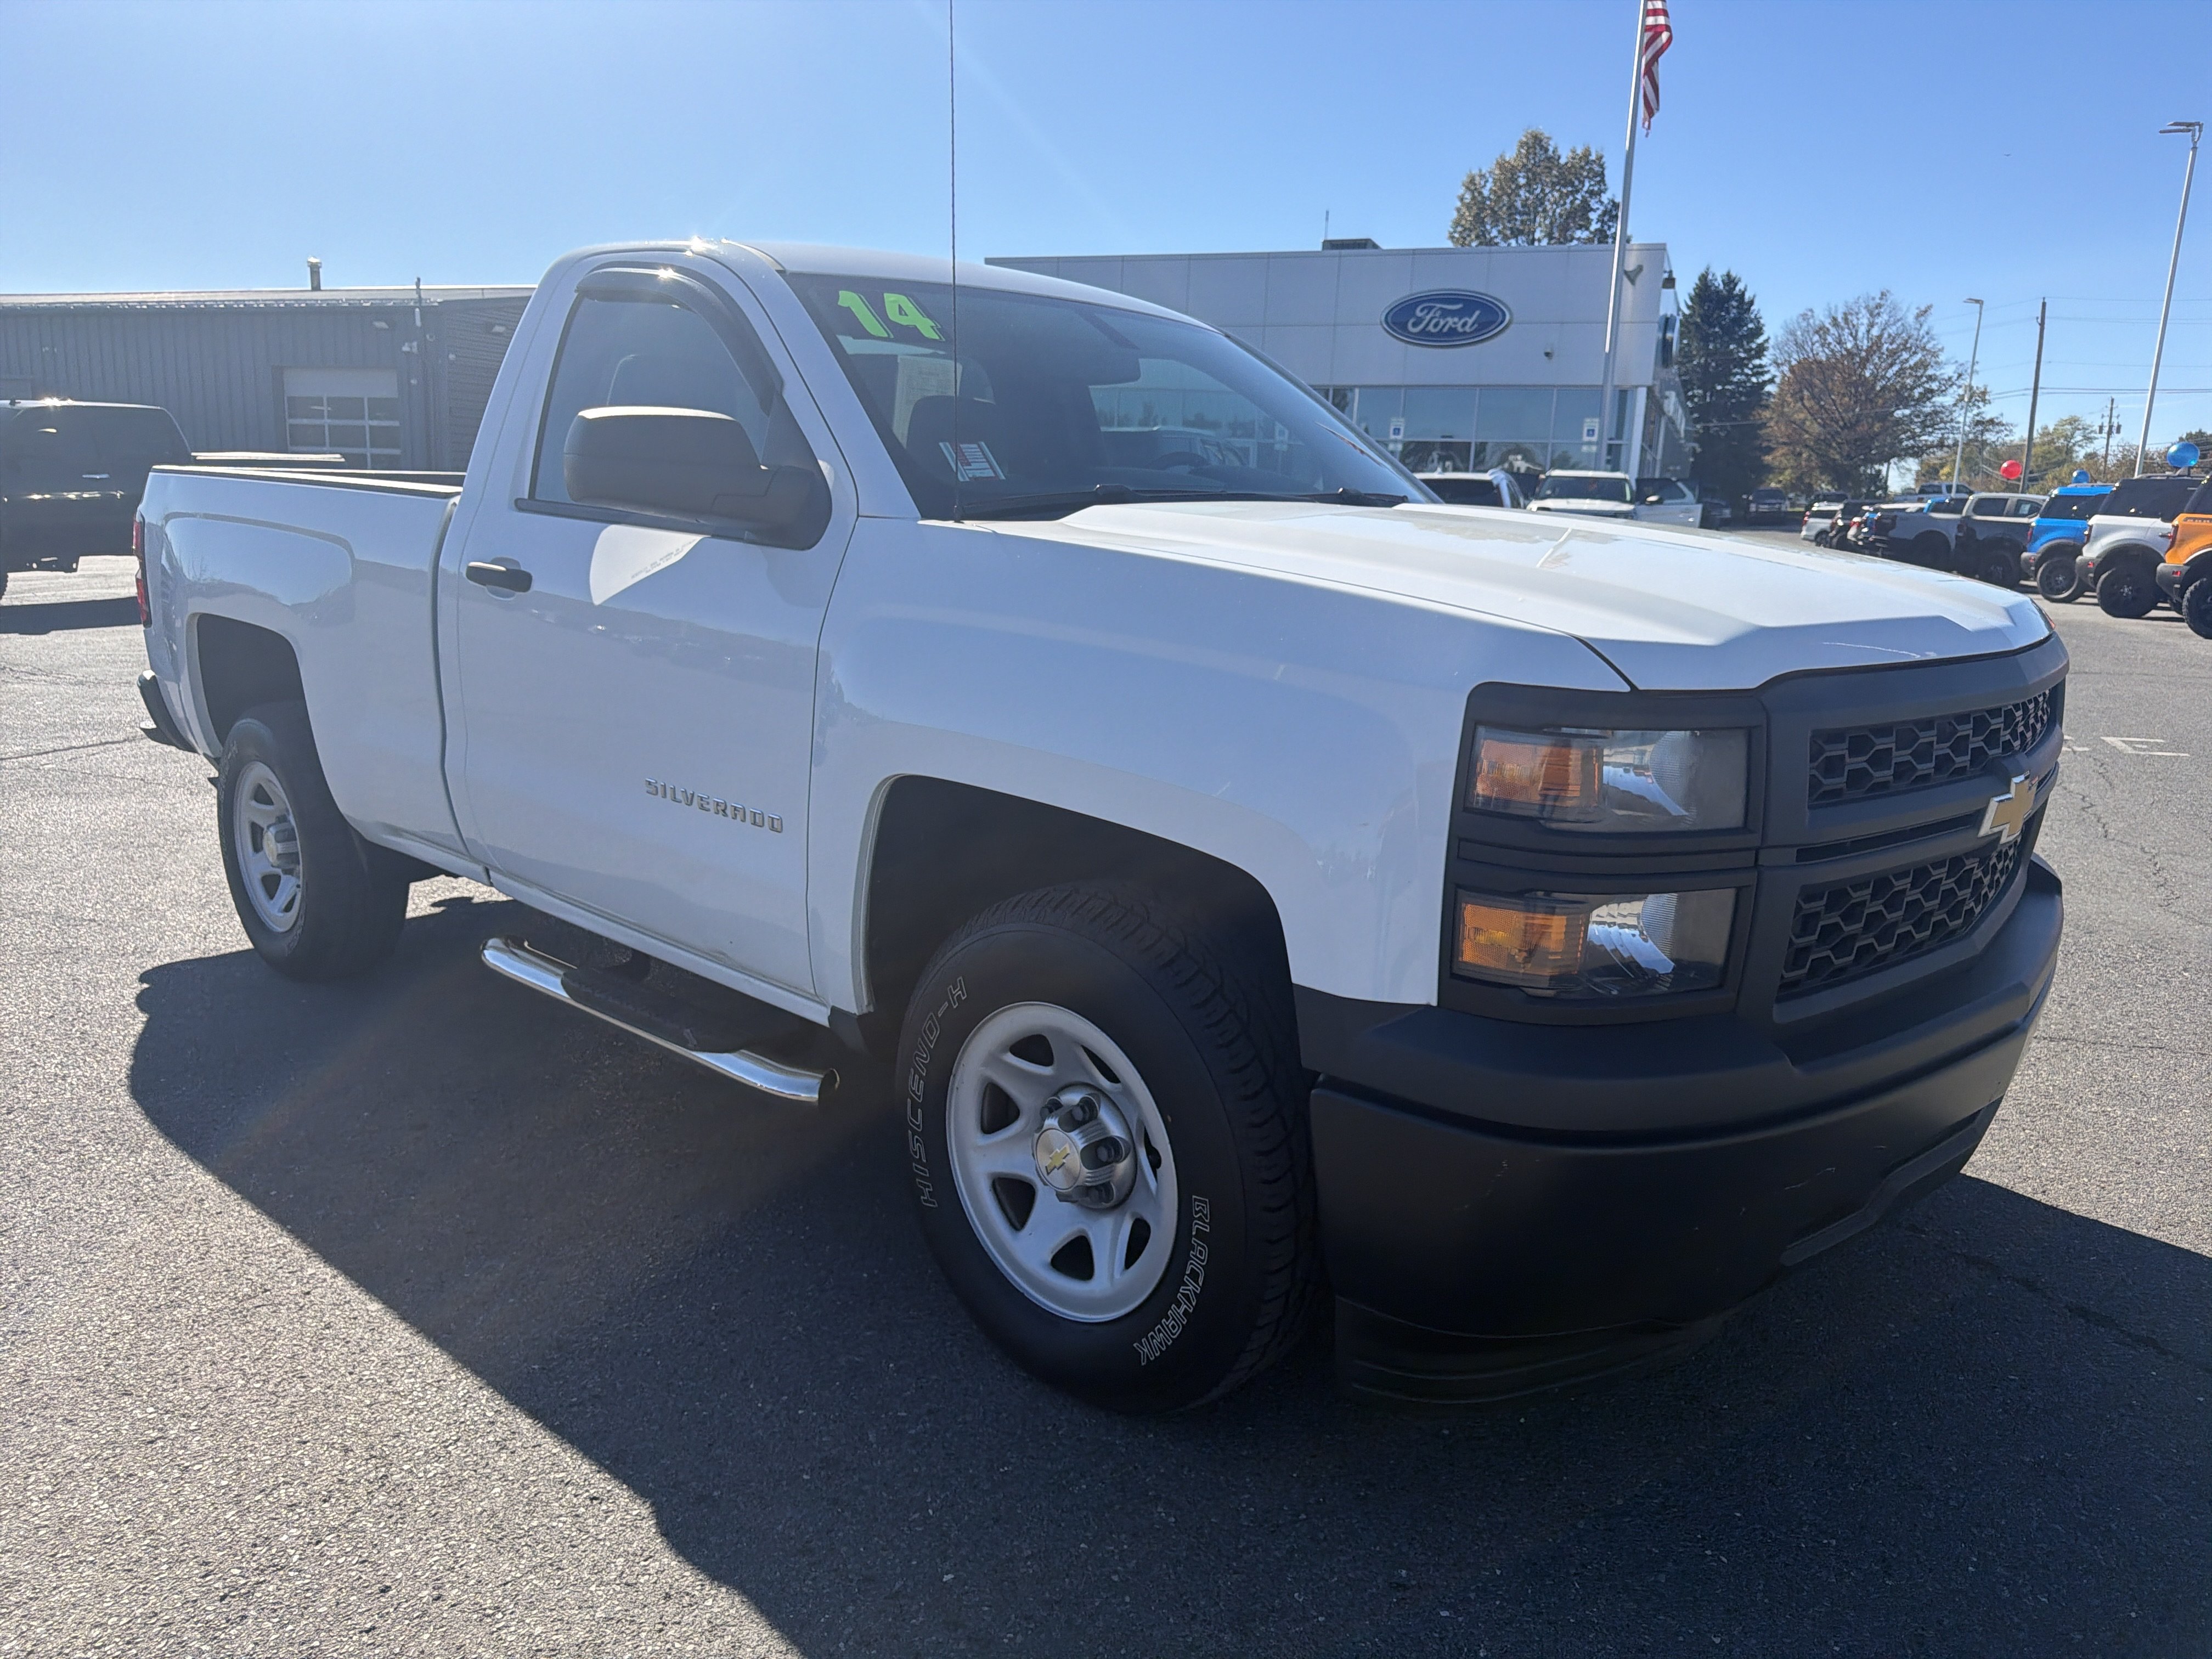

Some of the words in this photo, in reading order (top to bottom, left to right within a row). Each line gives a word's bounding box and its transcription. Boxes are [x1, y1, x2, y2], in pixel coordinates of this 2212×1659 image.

[837, 290, 945, 341] 14
[1407, 303, 1481, 333] Ford
[645, 777, 783, 833] SILVERADO
[907, 977, 967, 1208] HISCEND-H
[1133, 1195, 1210, 1365] BLACKHAWK
